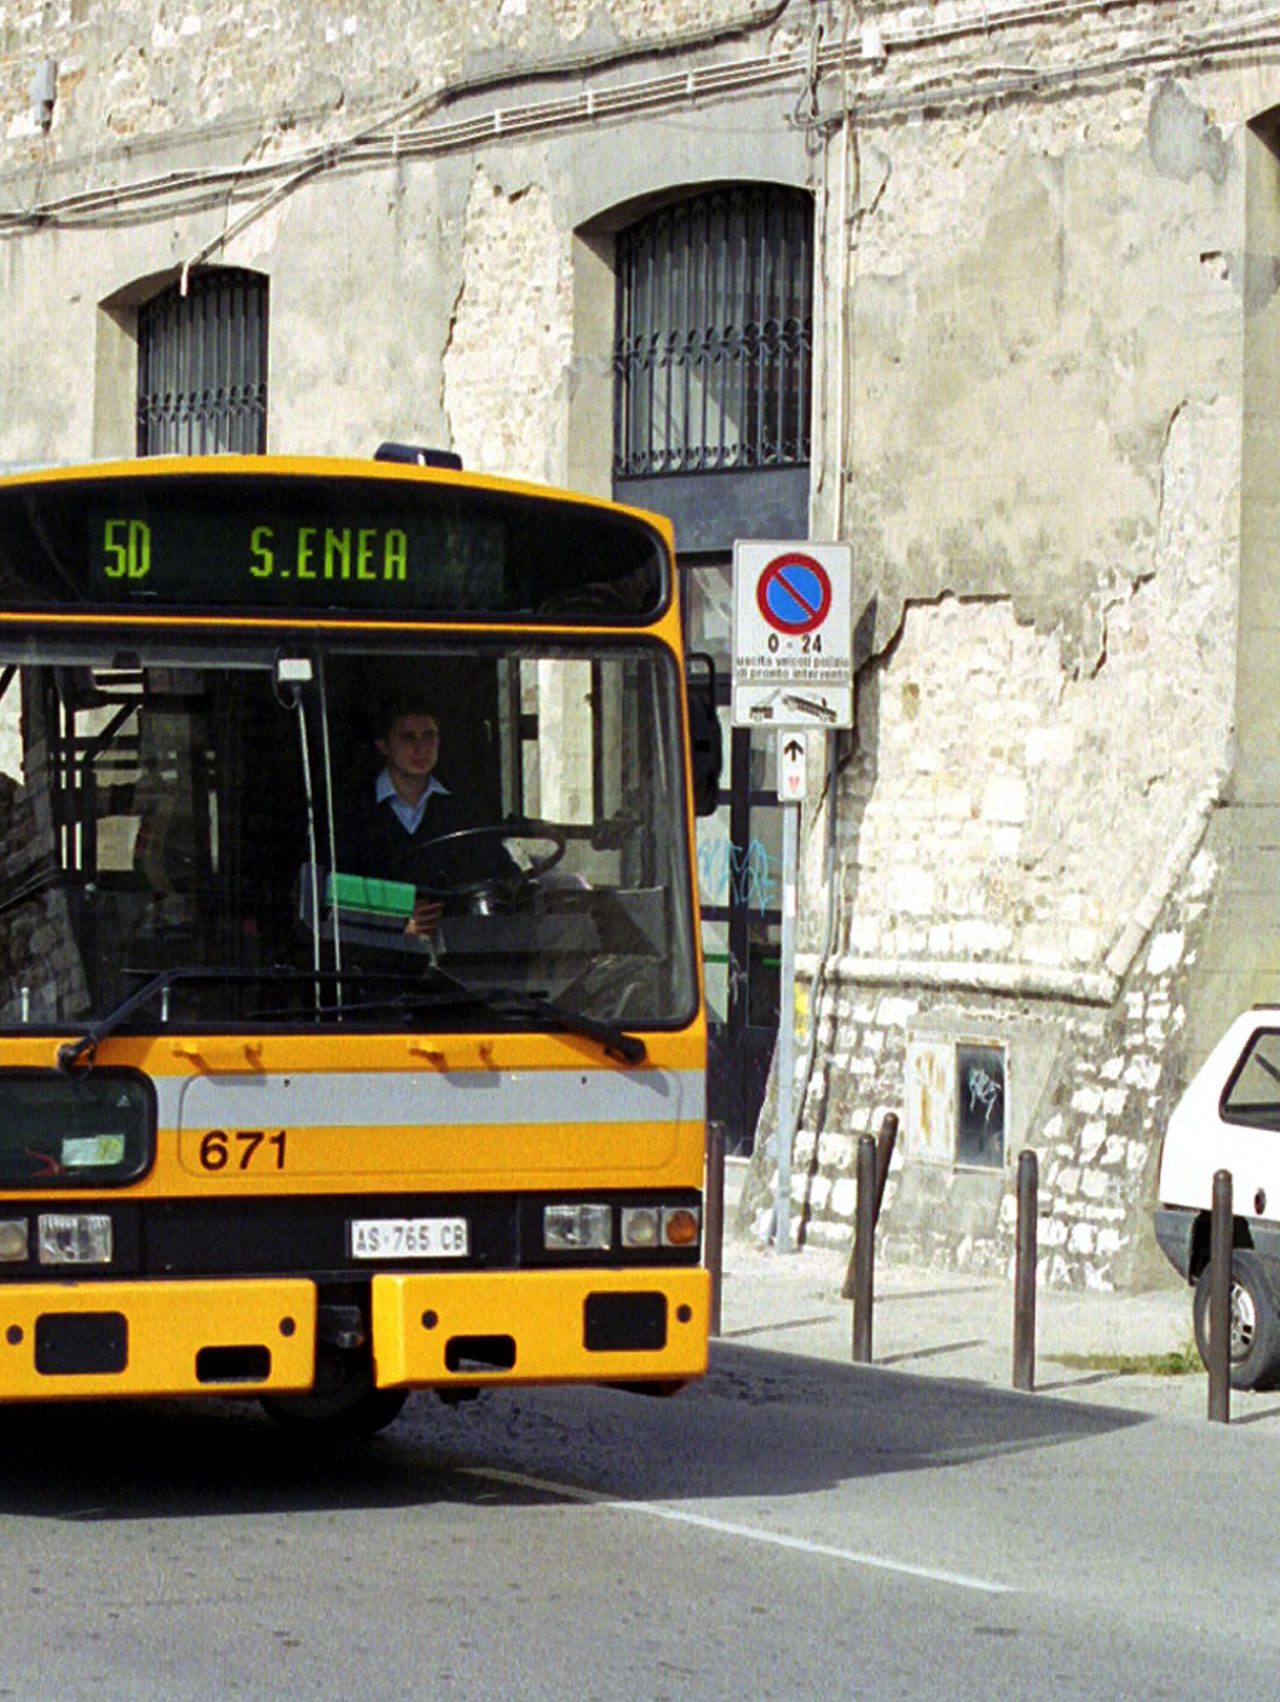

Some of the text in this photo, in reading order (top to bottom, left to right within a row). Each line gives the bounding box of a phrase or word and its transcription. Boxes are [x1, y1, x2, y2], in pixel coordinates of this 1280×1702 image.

[250, 526, 408, 580] S.ENEA
[768, 633, 779, 654] 0
[801, 633, 822, 655] 24
[200, 1130, 286, 1170] 671
